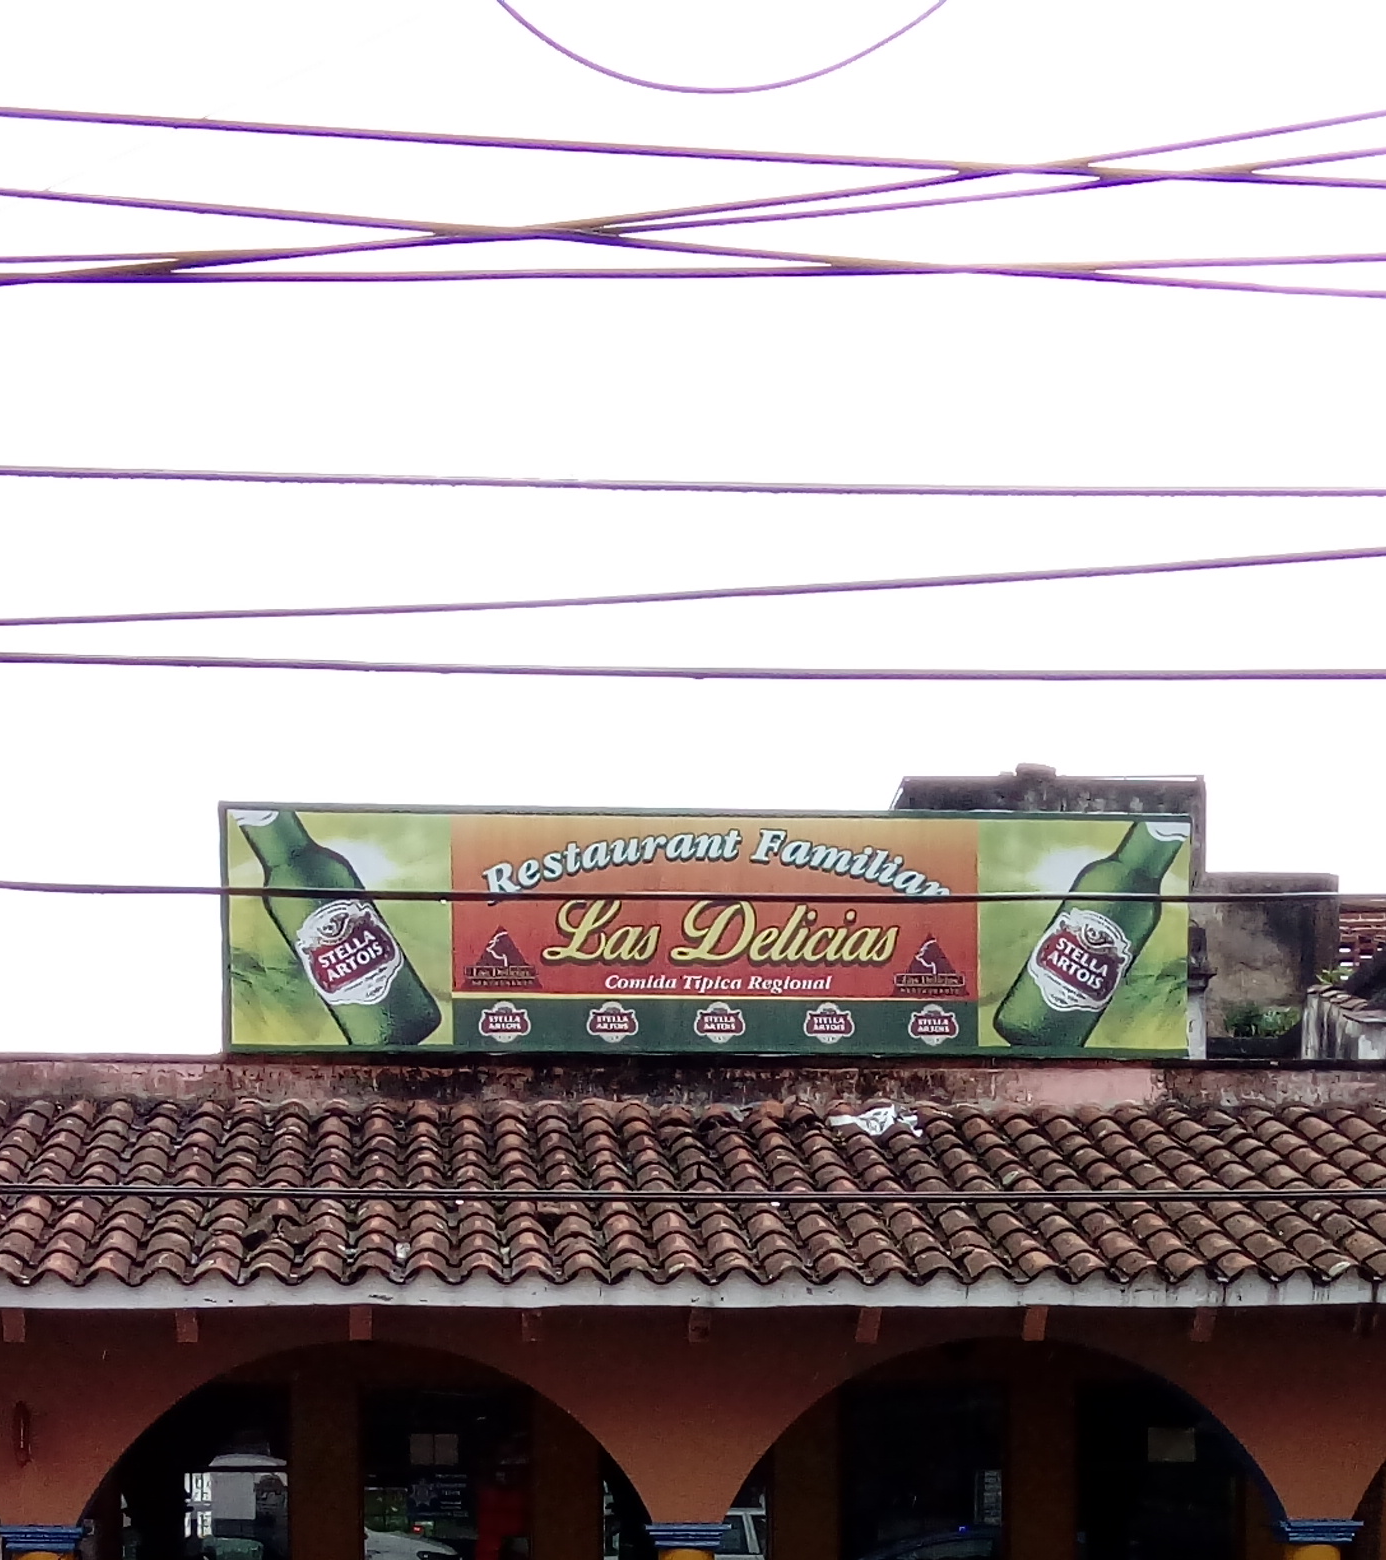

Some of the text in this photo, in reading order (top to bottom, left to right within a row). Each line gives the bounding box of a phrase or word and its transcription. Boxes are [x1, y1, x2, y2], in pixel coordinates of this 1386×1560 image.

[482, 828, 741, 907] Restaurant
[318, 930, 376, 968] STELLA
[542, 897, 900, 967] Las Delicias
[326, 941, 383, 981] ARTOIS
[1046, 950, 1104, 989] ARTOIS
[1056, 937, 1108, 977] STELLA
[605, 974, 677, 990] Comida
[748, 974, 832, 993] Regional
